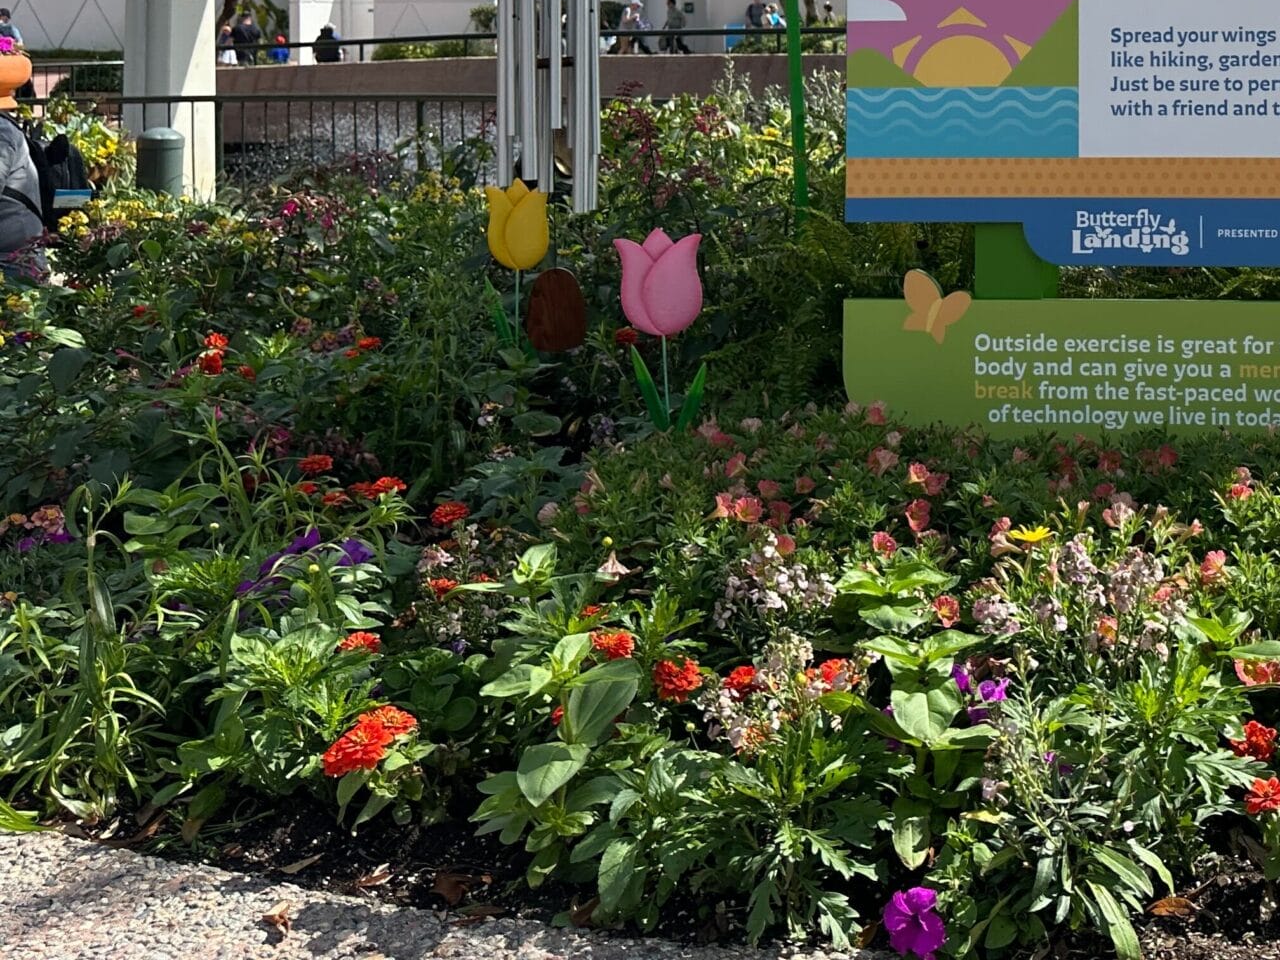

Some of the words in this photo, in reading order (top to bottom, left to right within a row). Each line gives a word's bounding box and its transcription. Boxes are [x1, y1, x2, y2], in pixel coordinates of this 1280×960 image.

[1110, 26, 1174, 48] Spread
[1177, 30, 1219, 48] your
[1221, 26, 1277, 47] wings
[1111, 50, 1145, 68] like
[1149, 50, 1214, 72] hiking,
[1110, 75, 1149, 92] Just
[1153, 74, 1175, 92] be
[1179, 79, 1220, 92] sure
[1223, 77, 1244, 92] to
[1110, 99, 1153, 117] with
[1157, 104, 1168, 116] a
[1171, 99, 1228, 116] friend
[1232, 98, 1268, 116] and
[1076, 208, 1161, 231] Butterfly
[1072, 226, 1190, 256] Landing
[1217, 228, 1279, 238] PRESENTED
[974, 332, 1058, 352] Outside
[1063, 333, 1151, 353] exercise
[1157, 334, 1175, 354] is
[1181, 337, 1238, 359] great
[1242, 335, 1275, 355] for
[974, 355, 1028, 381] body
[1032, 356, 1073, 376] and
[1079, 362, 1117, 377] can
[1123, 357, 1168, 383] give
[1173, 363, 1213, 383] you
[1219, 364, 1232, 378] a
[974, 379, 1034, 400] break
[1038, 380, 1088, 400] from
[1094, 380, 1130, 401] the
[1134, 381, 1247, 407] fast-paced
[988, 403, 1012, 423] of
[1011, 403, 1129, 430] technology
[1132, 410, 1164, 425] we
[1169, 405, 1206, 426] live
[1212, 407, 1230, 426] in
